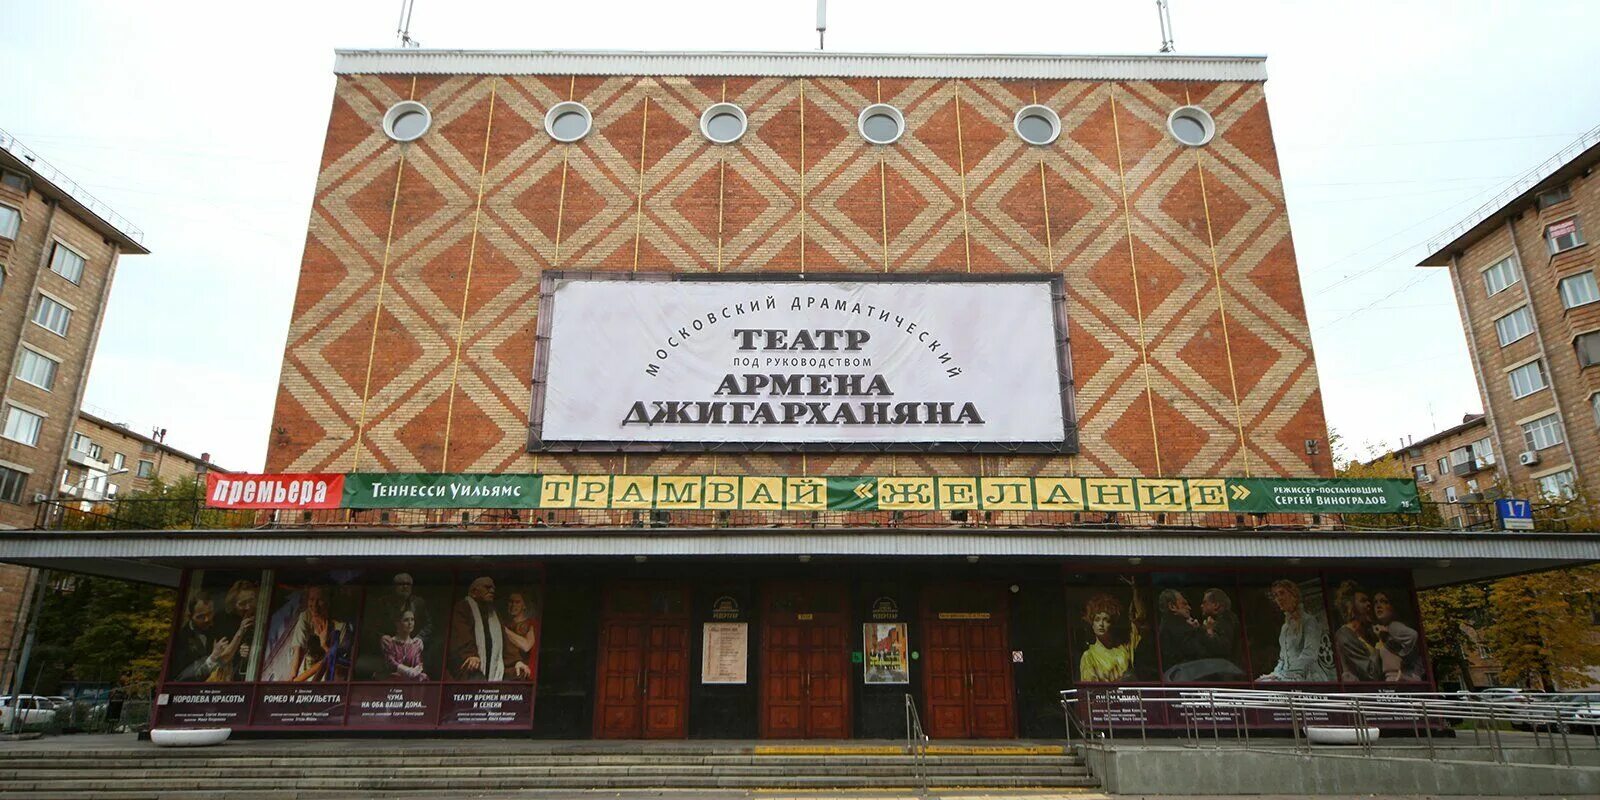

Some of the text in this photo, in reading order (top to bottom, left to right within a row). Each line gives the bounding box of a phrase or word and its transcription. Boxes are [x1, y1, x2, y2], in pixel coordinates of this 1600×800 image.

[645, 295, 962, 378] МОСКОВСКИЙ ДРАМАТИЧЕСКИЙ
[734, 329, 871, 352] ТЕАТР
[733, 357, 872, 369] ПОД РУКОВОДСТВОМ
[714, 373, 893, 396] АРМЕНА
[622, 400, 985, 427] ДЖИГАРХАНЯНА
[212, 479, 327, 505] премьера
[545, 479, 825, 504] ТРАМВАЙ
[1273, 486, 1384, 494] РЕЖИССЕР-ПОСТАНОВЩИК
[1506, 501, 1526, 517] 17
[173, 694, 245, 704] КОРОЛЕВА КРАСОТЫ
[263, 694, 341, 704] РОМЕО И ДЖУЛЬЕТТА
